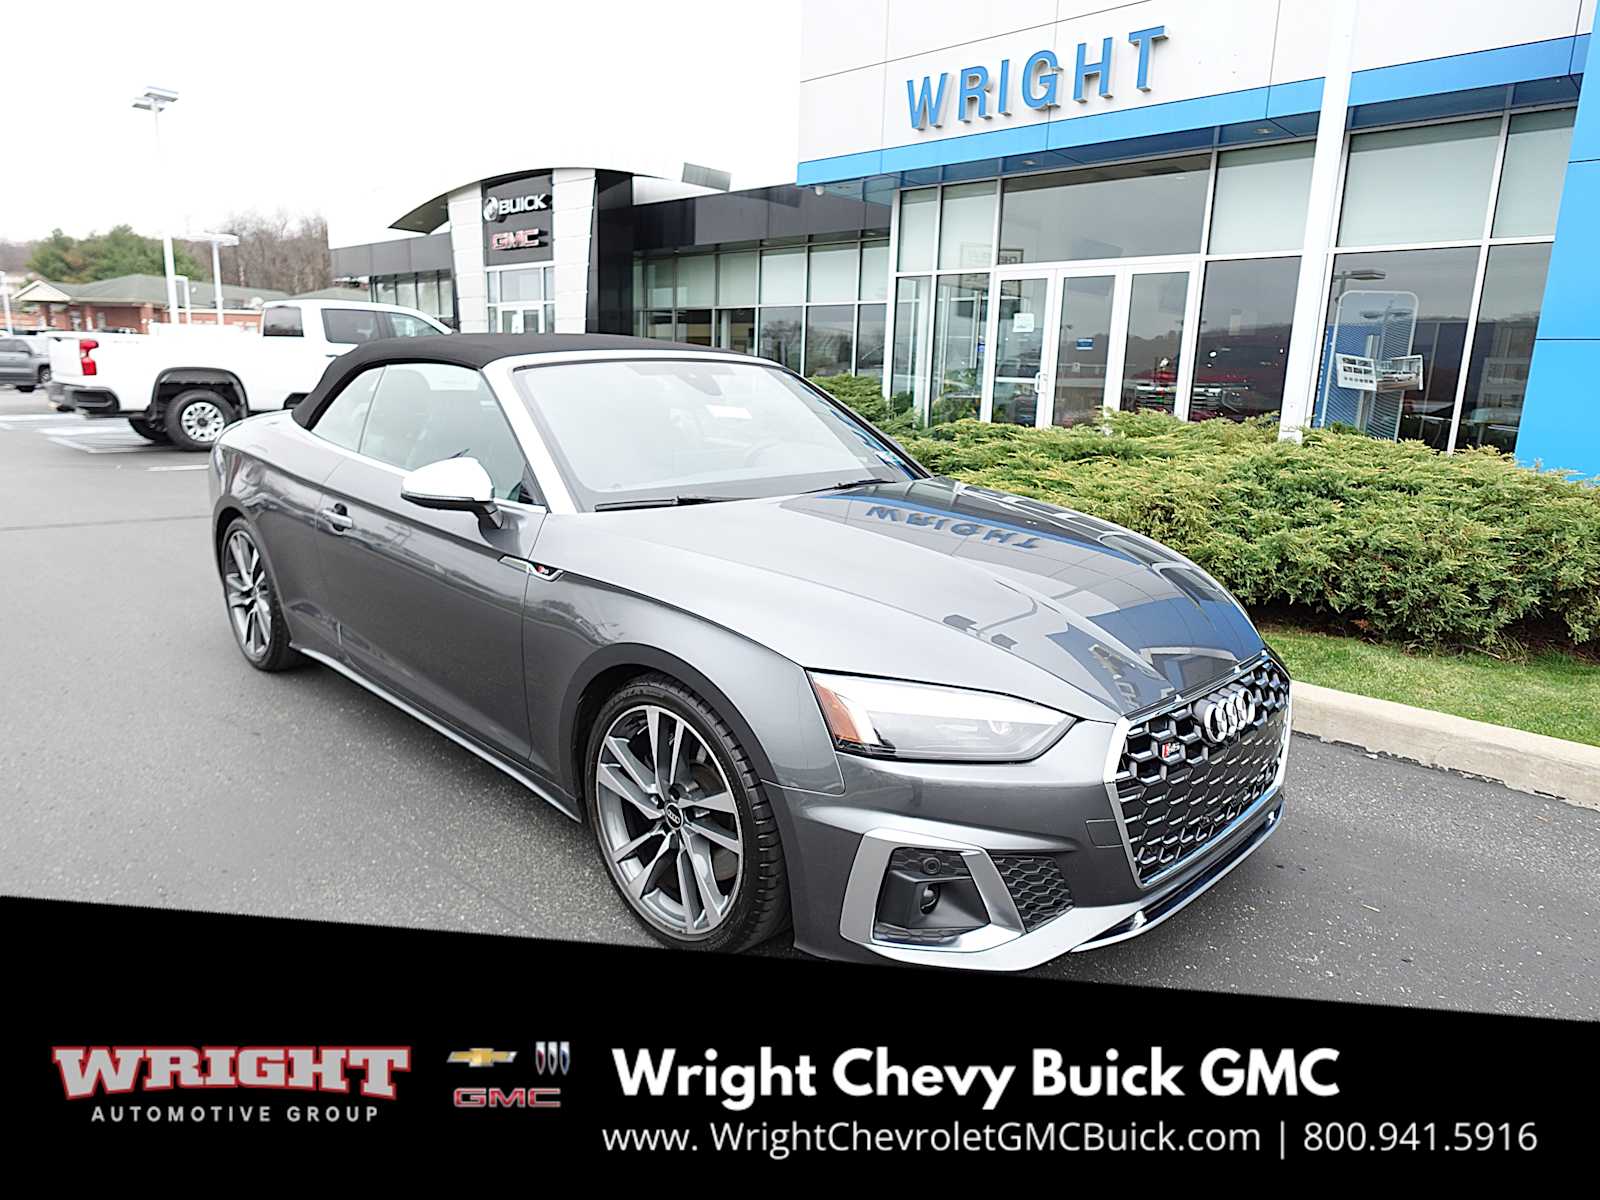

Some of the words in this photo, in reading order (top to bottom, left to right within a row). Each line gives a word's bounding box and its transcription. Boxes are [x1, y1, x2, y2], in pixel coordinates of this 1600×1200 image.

[906, 25, 1170, 131] WRIGHT
[499, 193, 547, 215] BUICK
[492, 228, 540, 250] GMC
